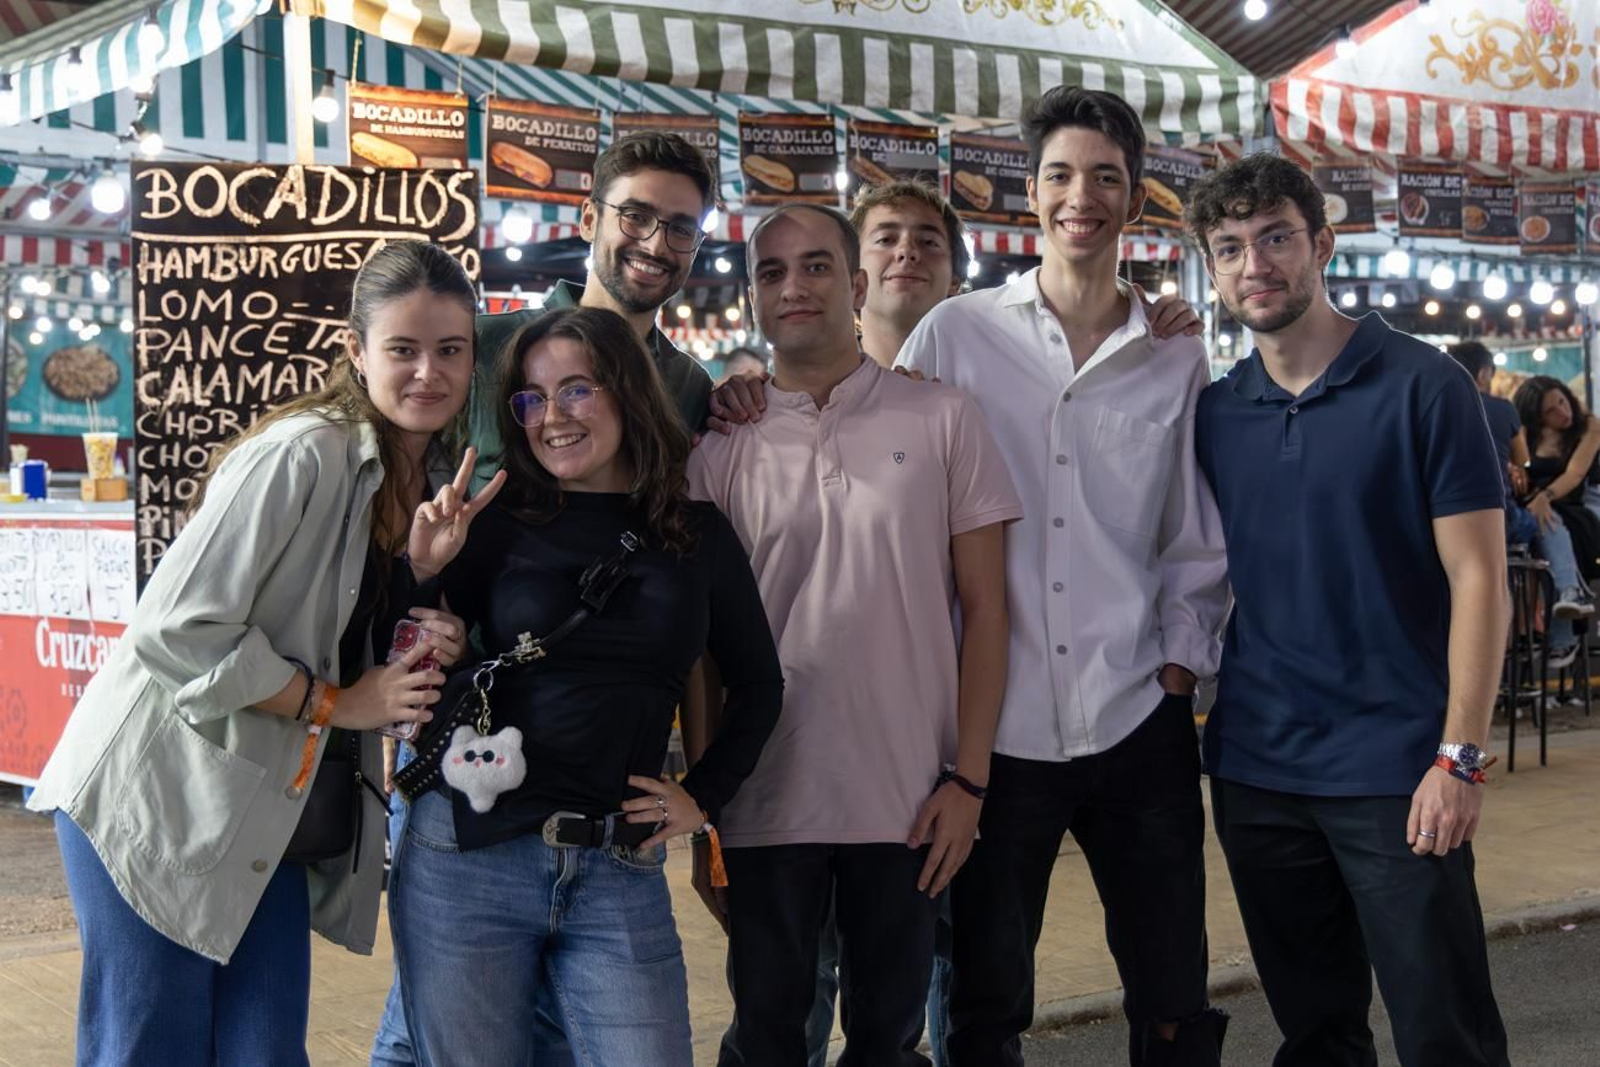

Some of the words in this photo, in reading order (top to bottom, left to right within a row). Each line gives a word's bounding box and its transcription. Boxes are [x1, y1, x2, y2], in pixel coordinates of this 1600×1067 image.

[353, 102, 465, 127] BOCADILLO
[370, 123, 383, 133] DE
[492, 114, 597, 141] BOCADILLO
[742, 127, 833, 144] BOCADILLO
[525, 136, 540, 147] DE
[542, 139, 596, 154] PERRITOS
[754, 145, 766, 153] DE
[768, 145, 834, 155] CALAMARES
[849, 134, 937, 156] BOCADILLO
[872, 152, 886, 162] DE
[1401, 173, 1441, 187] RACIÓN
[1444, 176, 1460, 188] DE
[138, 289, 278, 322] LOMO
